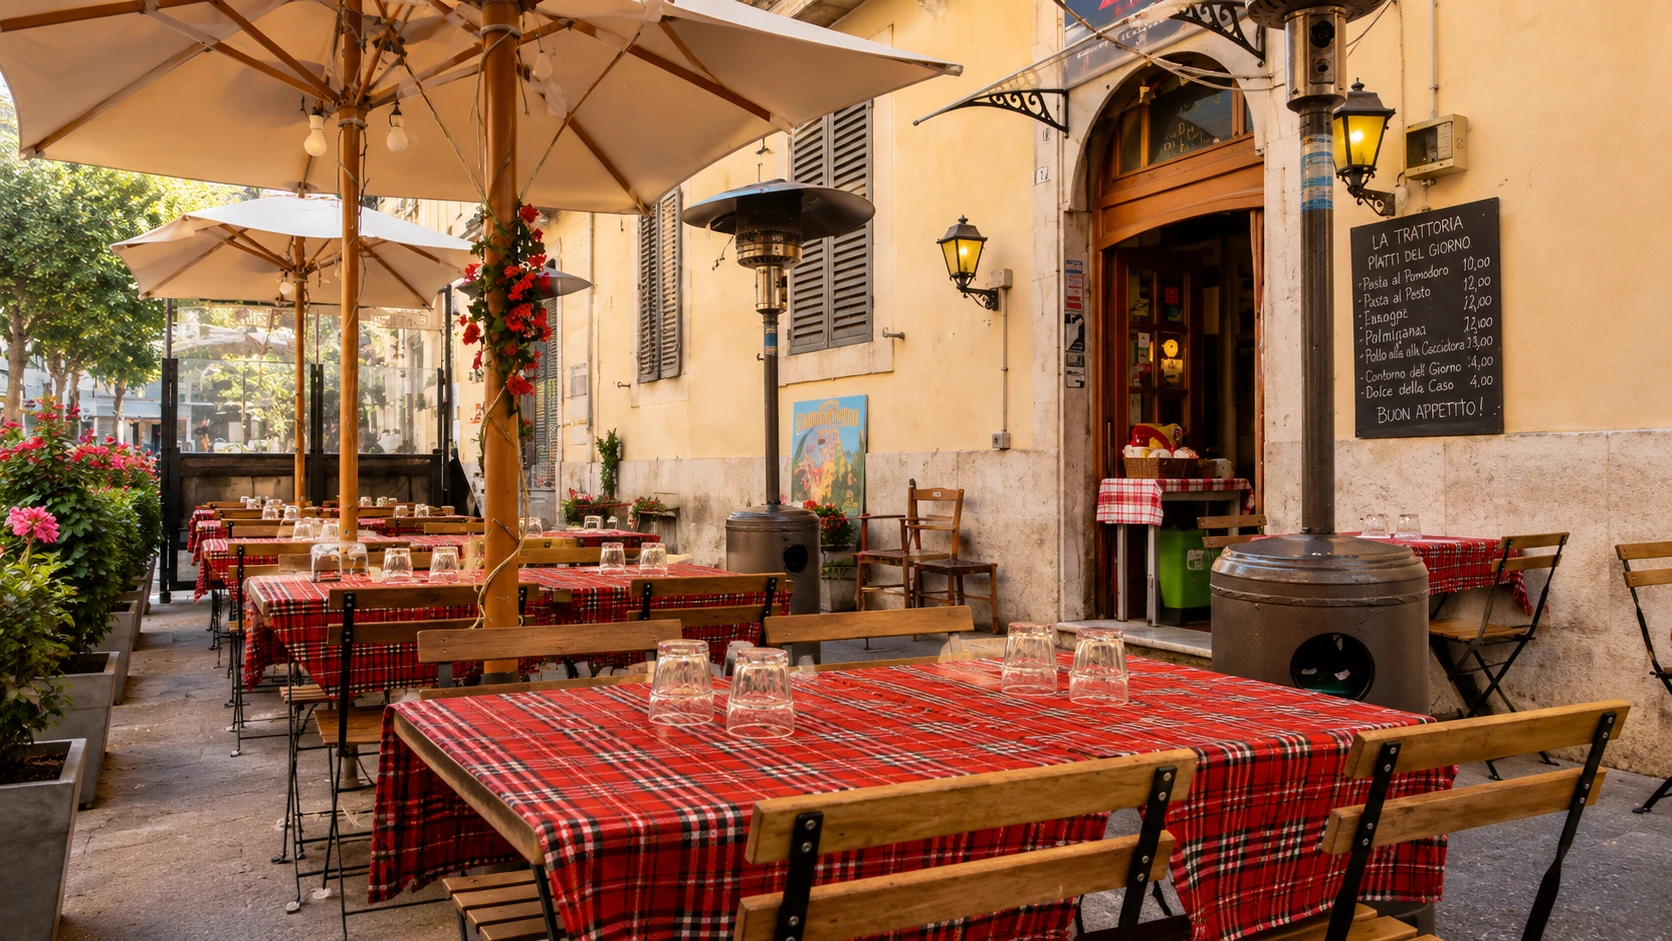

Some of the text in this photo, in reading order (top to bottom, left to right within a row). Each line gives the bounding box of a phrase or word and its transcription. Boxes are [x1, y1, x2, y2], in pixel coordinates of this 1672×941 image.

[1371, 215, 1464, 250] LA TRATTORIA
[1368, 236, 1471, 270] PIATTI DEL GIORNO
[1392, 271, 1401, 286] al
[1463, 256, 1491, 272] 10,00
[1393, 289, 1402, 304] al
[1463, 276, 1491, 292] 12,00
[1365, 348, 1387, 364] Pollo
[1365, 369, 1406, 383] Contorno
[1429, 361, 1462, 376] Giorno
[1365, 385, 1393, 399] Dolce
[1398, 380, 1424, 395] della
